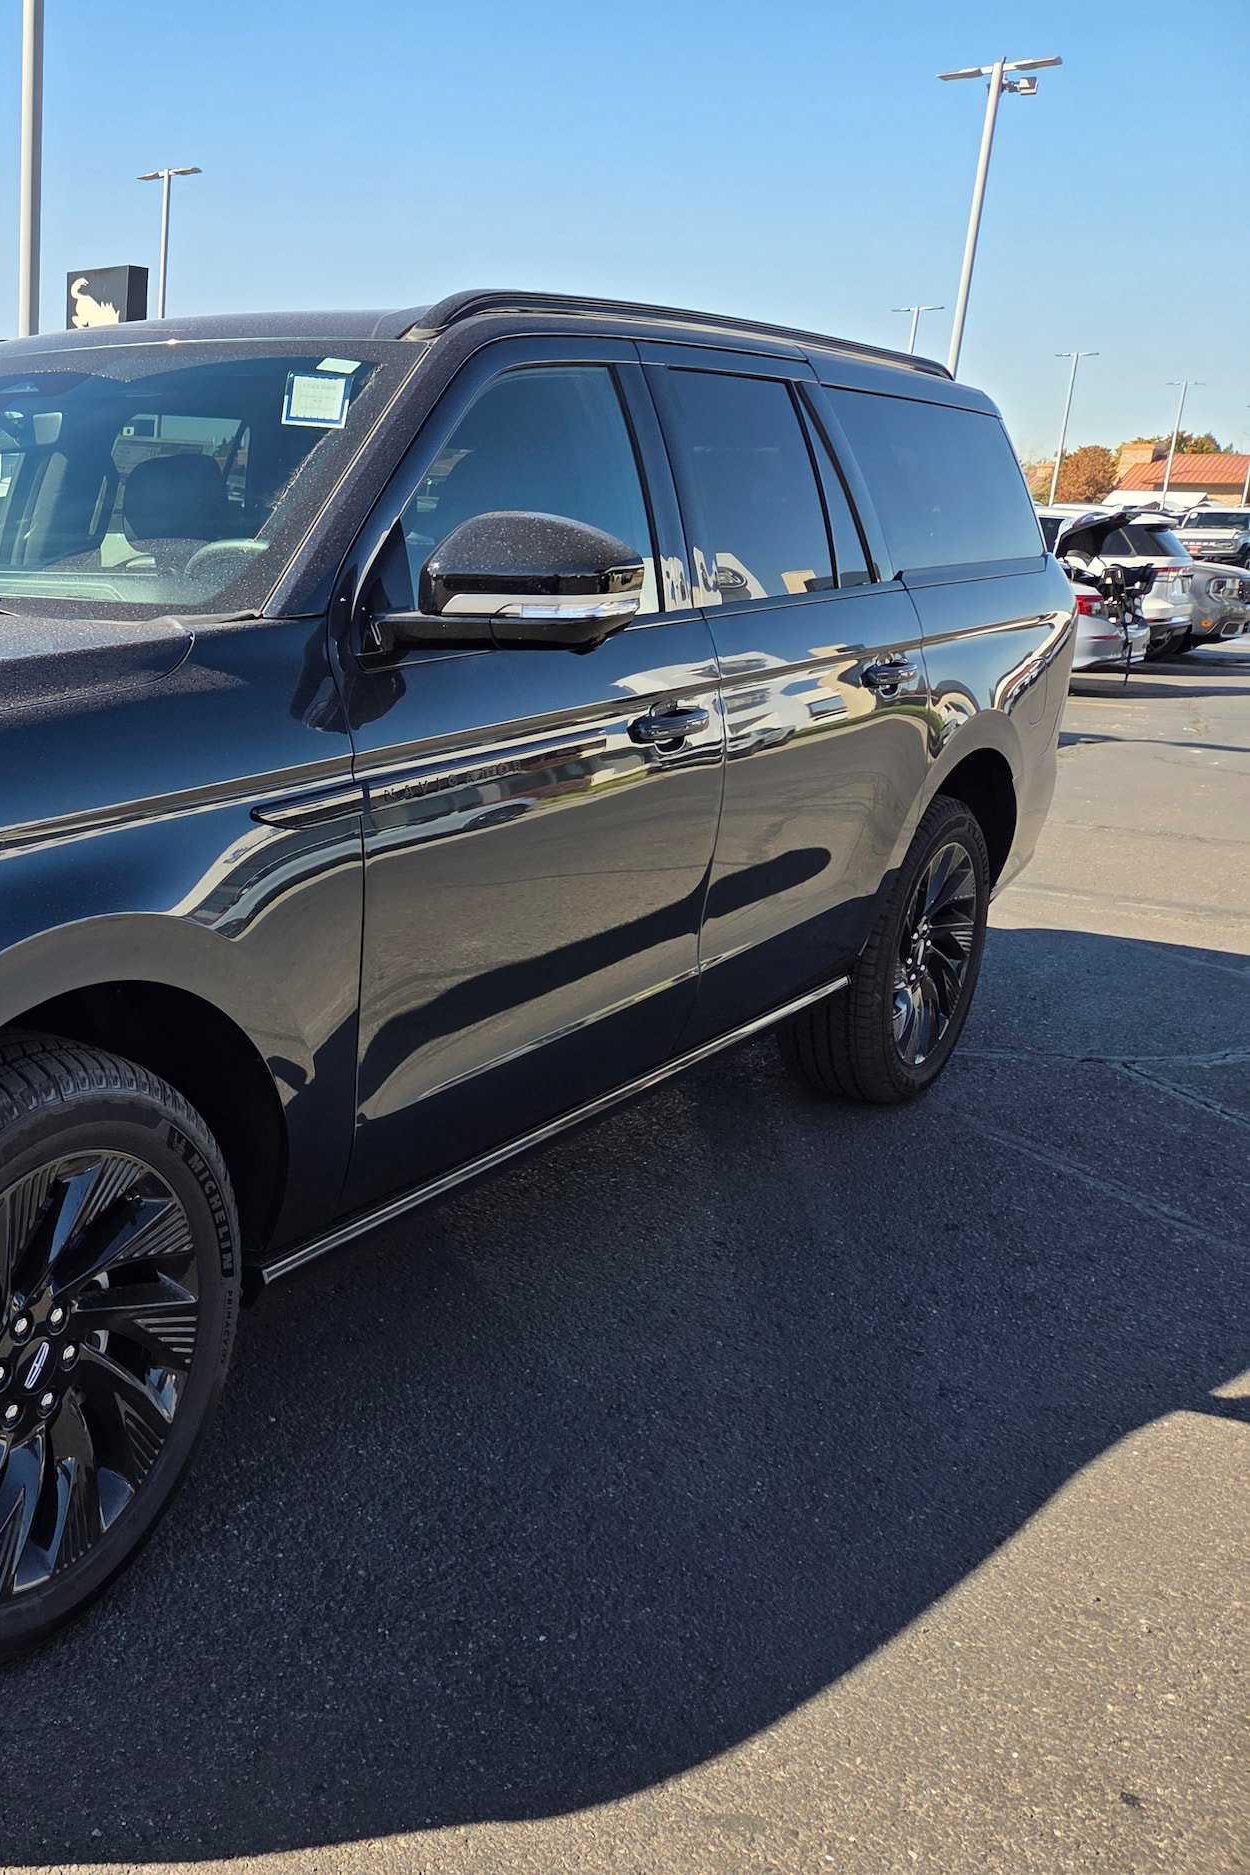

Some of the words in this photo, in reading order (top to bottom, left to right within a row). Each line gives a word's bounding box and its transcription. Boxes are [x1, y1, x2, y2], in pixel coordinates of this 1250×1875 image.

[383, 760, 523, 801] NAVIGATOR
[187, 1152, 233, 1270] MICHELIN
[222, 1289, 233, 1346] PRIMACY
